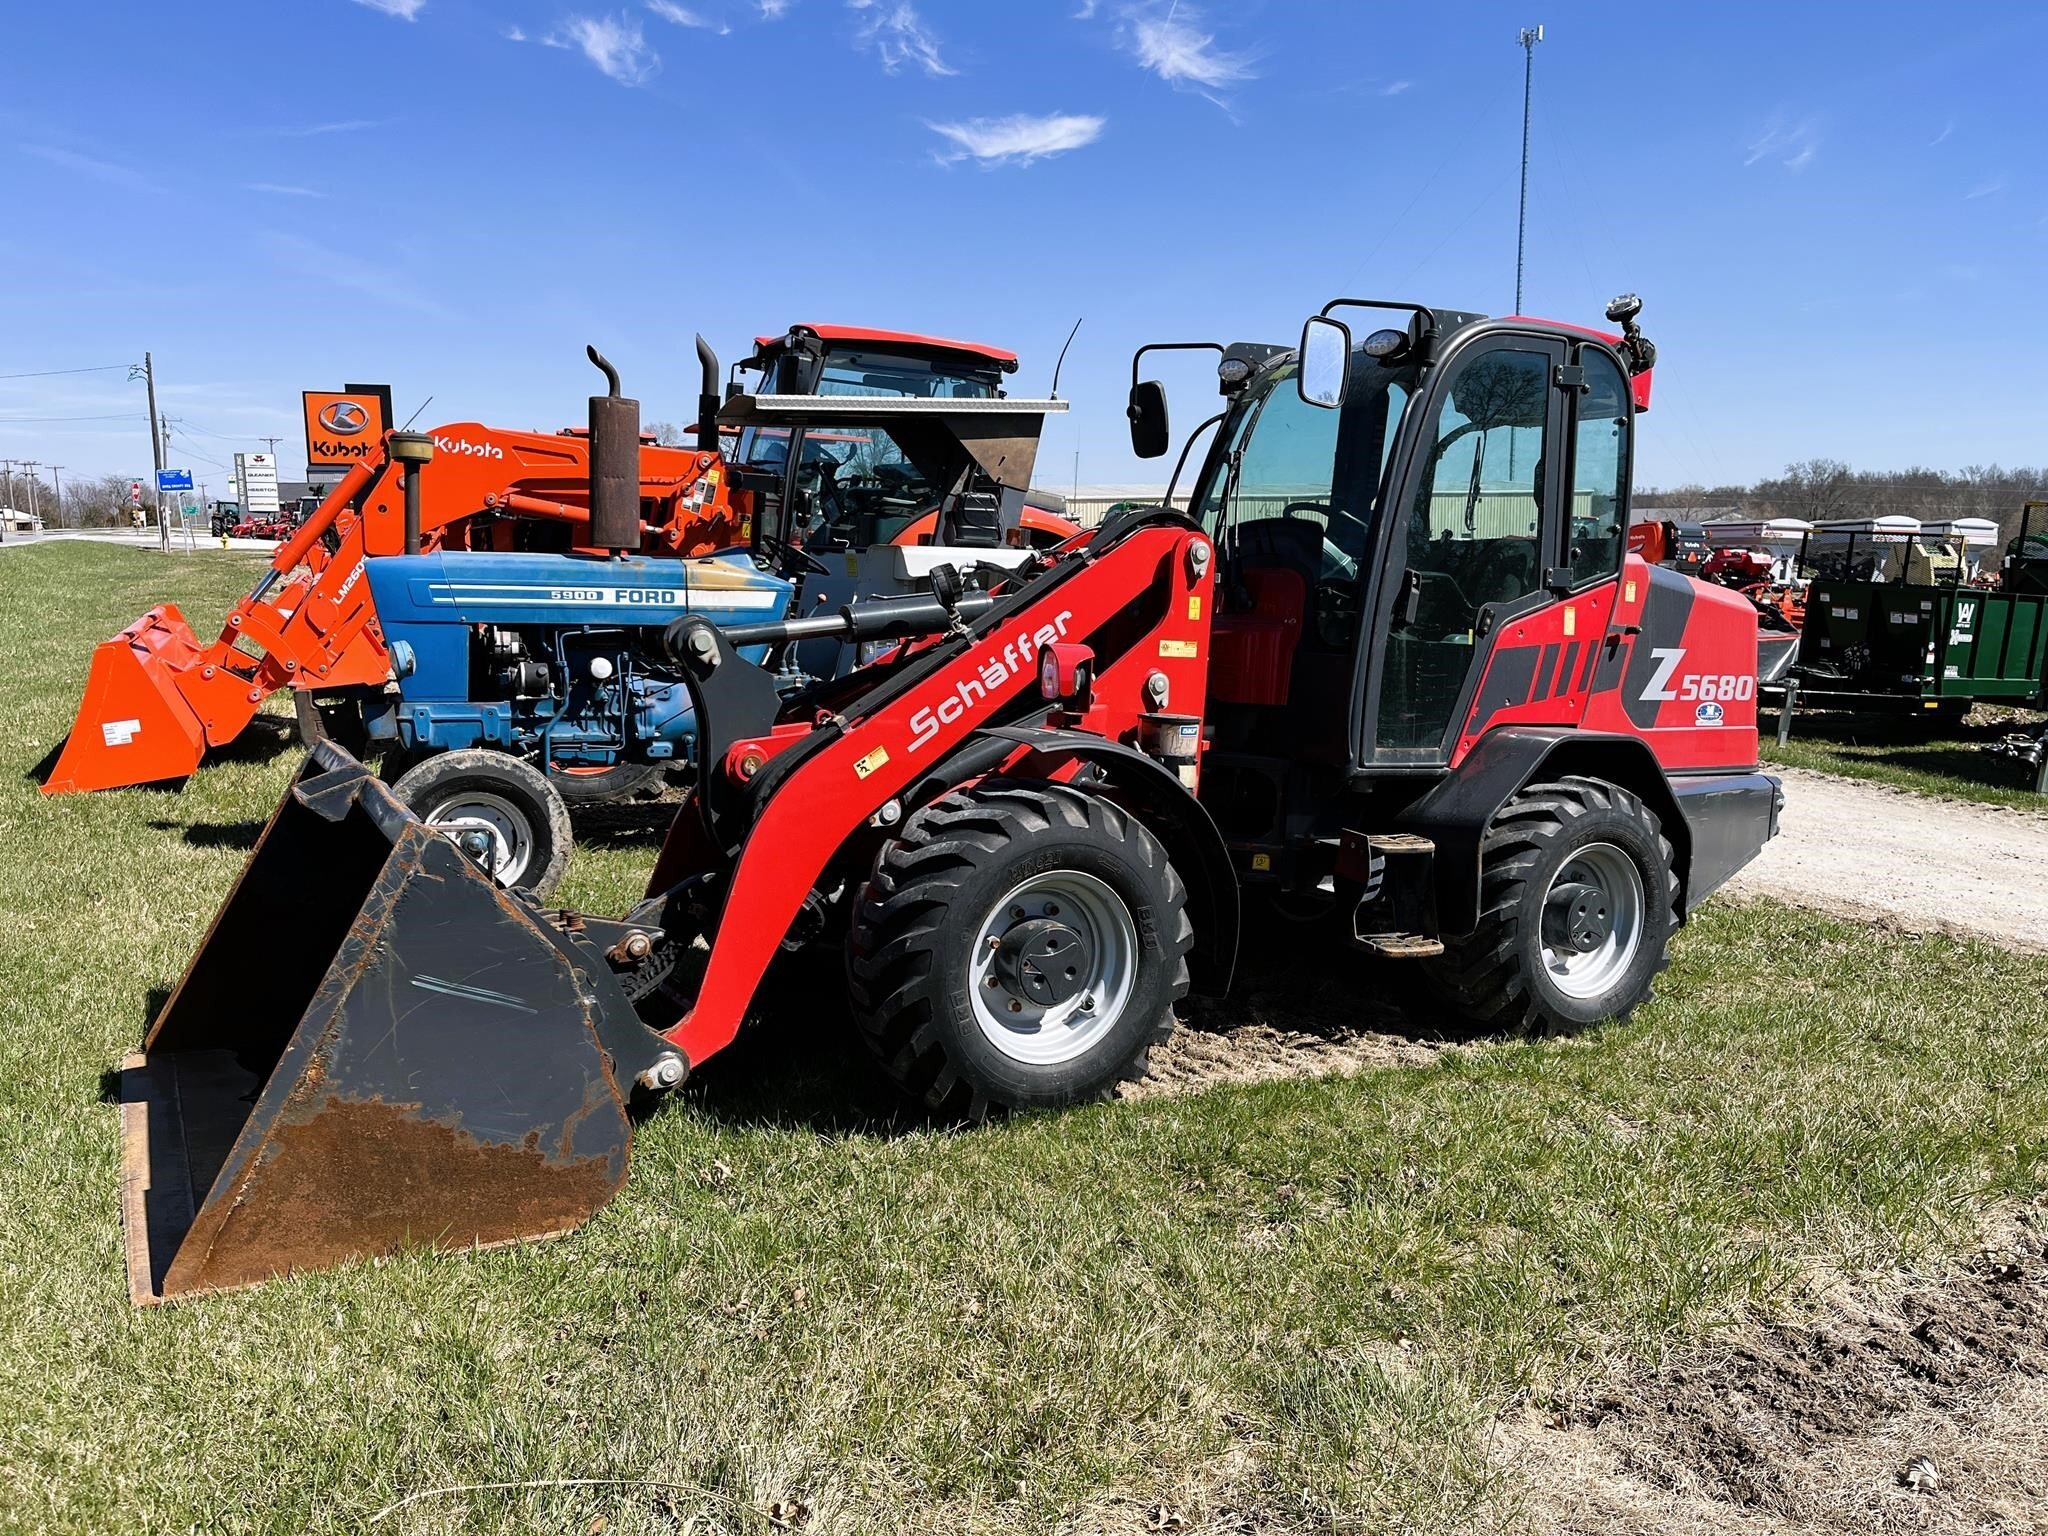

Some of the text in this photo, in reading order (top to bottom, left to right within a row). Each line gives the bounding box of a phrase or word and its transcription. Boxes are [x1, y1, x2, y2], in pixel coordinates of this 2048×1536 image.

[313, 441, 375, 457] Kubot
[434, 436, 503, 459] Kubota
[550, 589, 675, 604] 5900 FORD
[907, 610, 1072, 753] Schäffer
[1638, 647, 1754, 701] Z 5680
[1182, 727, 1197, 735] SKF
